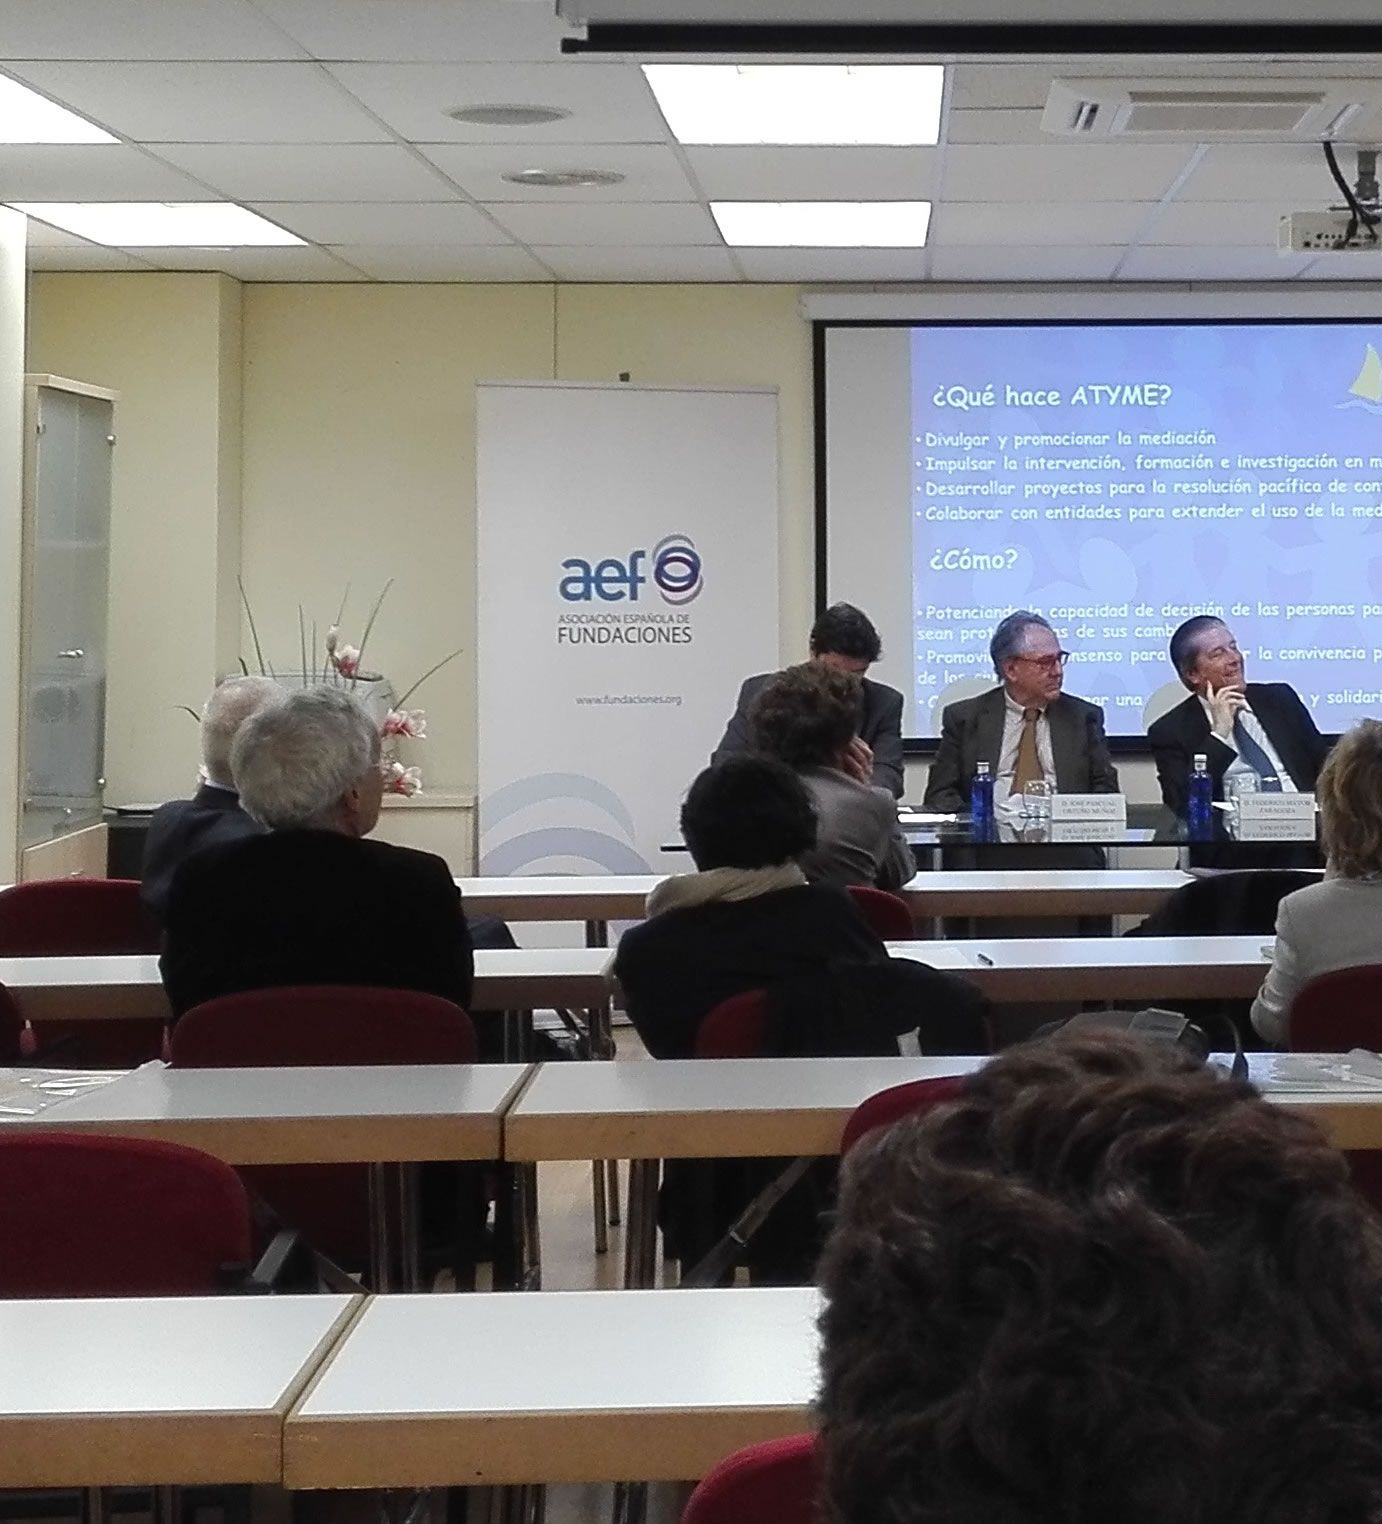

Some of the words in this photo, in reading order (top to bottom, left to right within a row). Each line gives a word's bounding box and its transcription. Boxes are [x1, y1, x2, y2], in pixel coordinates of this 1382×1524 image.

[933, 384, 995, 410] ¿Qué
[1005, 385, 1060, 406] hace
[1071, 384, 1172, 406] ATYME?
[926, 432, 989, 450] Divulgar
[999, 433, 1008, 449] y
[1014, 432, 1110, 449] promocionar
[1118, 431, 1132, 445] la
[1139, 430, 1216, 445] mediación
[926, 456, 996, 474] Impulsar
[1004, 456, 1017, 470] la
[1025, 454, 1126, 471] intervención,
[1136, 453, 1214, 470] formación
[1221, 458, 1230, 468] e
[1237, 453, 1337, 472] investigación
[1345, 458, 1363, 468] en
[926, 481, 1016, 496] Desarrollar
[1024, 481, 1103, 498] proyectos
[1110, 483, 1145, 497] para
[1152, 480, 1166, 494] la
[1174, 478, 1251, 494] resolución
[1259, 478, 1322, 497] pacífica
[1328, 479, 1347, 493] de
[926, 506, 1003, 520] Colaborar
[1011, 508, 1038, 520] con
[1045, 504, 1122, 519] entidades
[1129, 507, 1165, 522] para
[1172, 503, 1243, 518] extender
[1252, 503, 1265, 517] el
[1272, 507, 1298, 518] uso
[1305, 503, 1323, 517] de
[1331, 503, 1345, 517] la
[930, 547, 1018, 570] ¿Cómo?
[560, 550, 646, 601] aef
[558, 613, 621, 624] ASOCIACIÓN
[624, 613, 674, 624] ESPAÑOLA
[676, 614, 690, 624] DE
[926, 604, 1015, 620] Potenciand
[1050, 604, 1128, 621] capacidad
[1135, 603, 1154, 618] de
[1161, 601, 1224, 617] decisión
[1232, 603, 1250, 616] de
[1257, 601, 1279, 616] las
[1286, 604, 1355, 619] personas
[558, 627, 692, 643] FUNDACIONES
[917, 629, 953, 640] sean
[1076, 623, 1095, 638] de
[1103, 627, 1127, 638] sus
[1134, 623, 1176, 638] camb
[1131, 650, 1166, 665] para
[1259, 646, 1272, 660] la
[1279, 645, 1365, 660] convivencia
[918, 671, 937, 684] de
[576, 695, 682, 706] www.fundaciones.org
[1116, 696, 1143, 706] una
[1310, 693, 1320, 708] y
